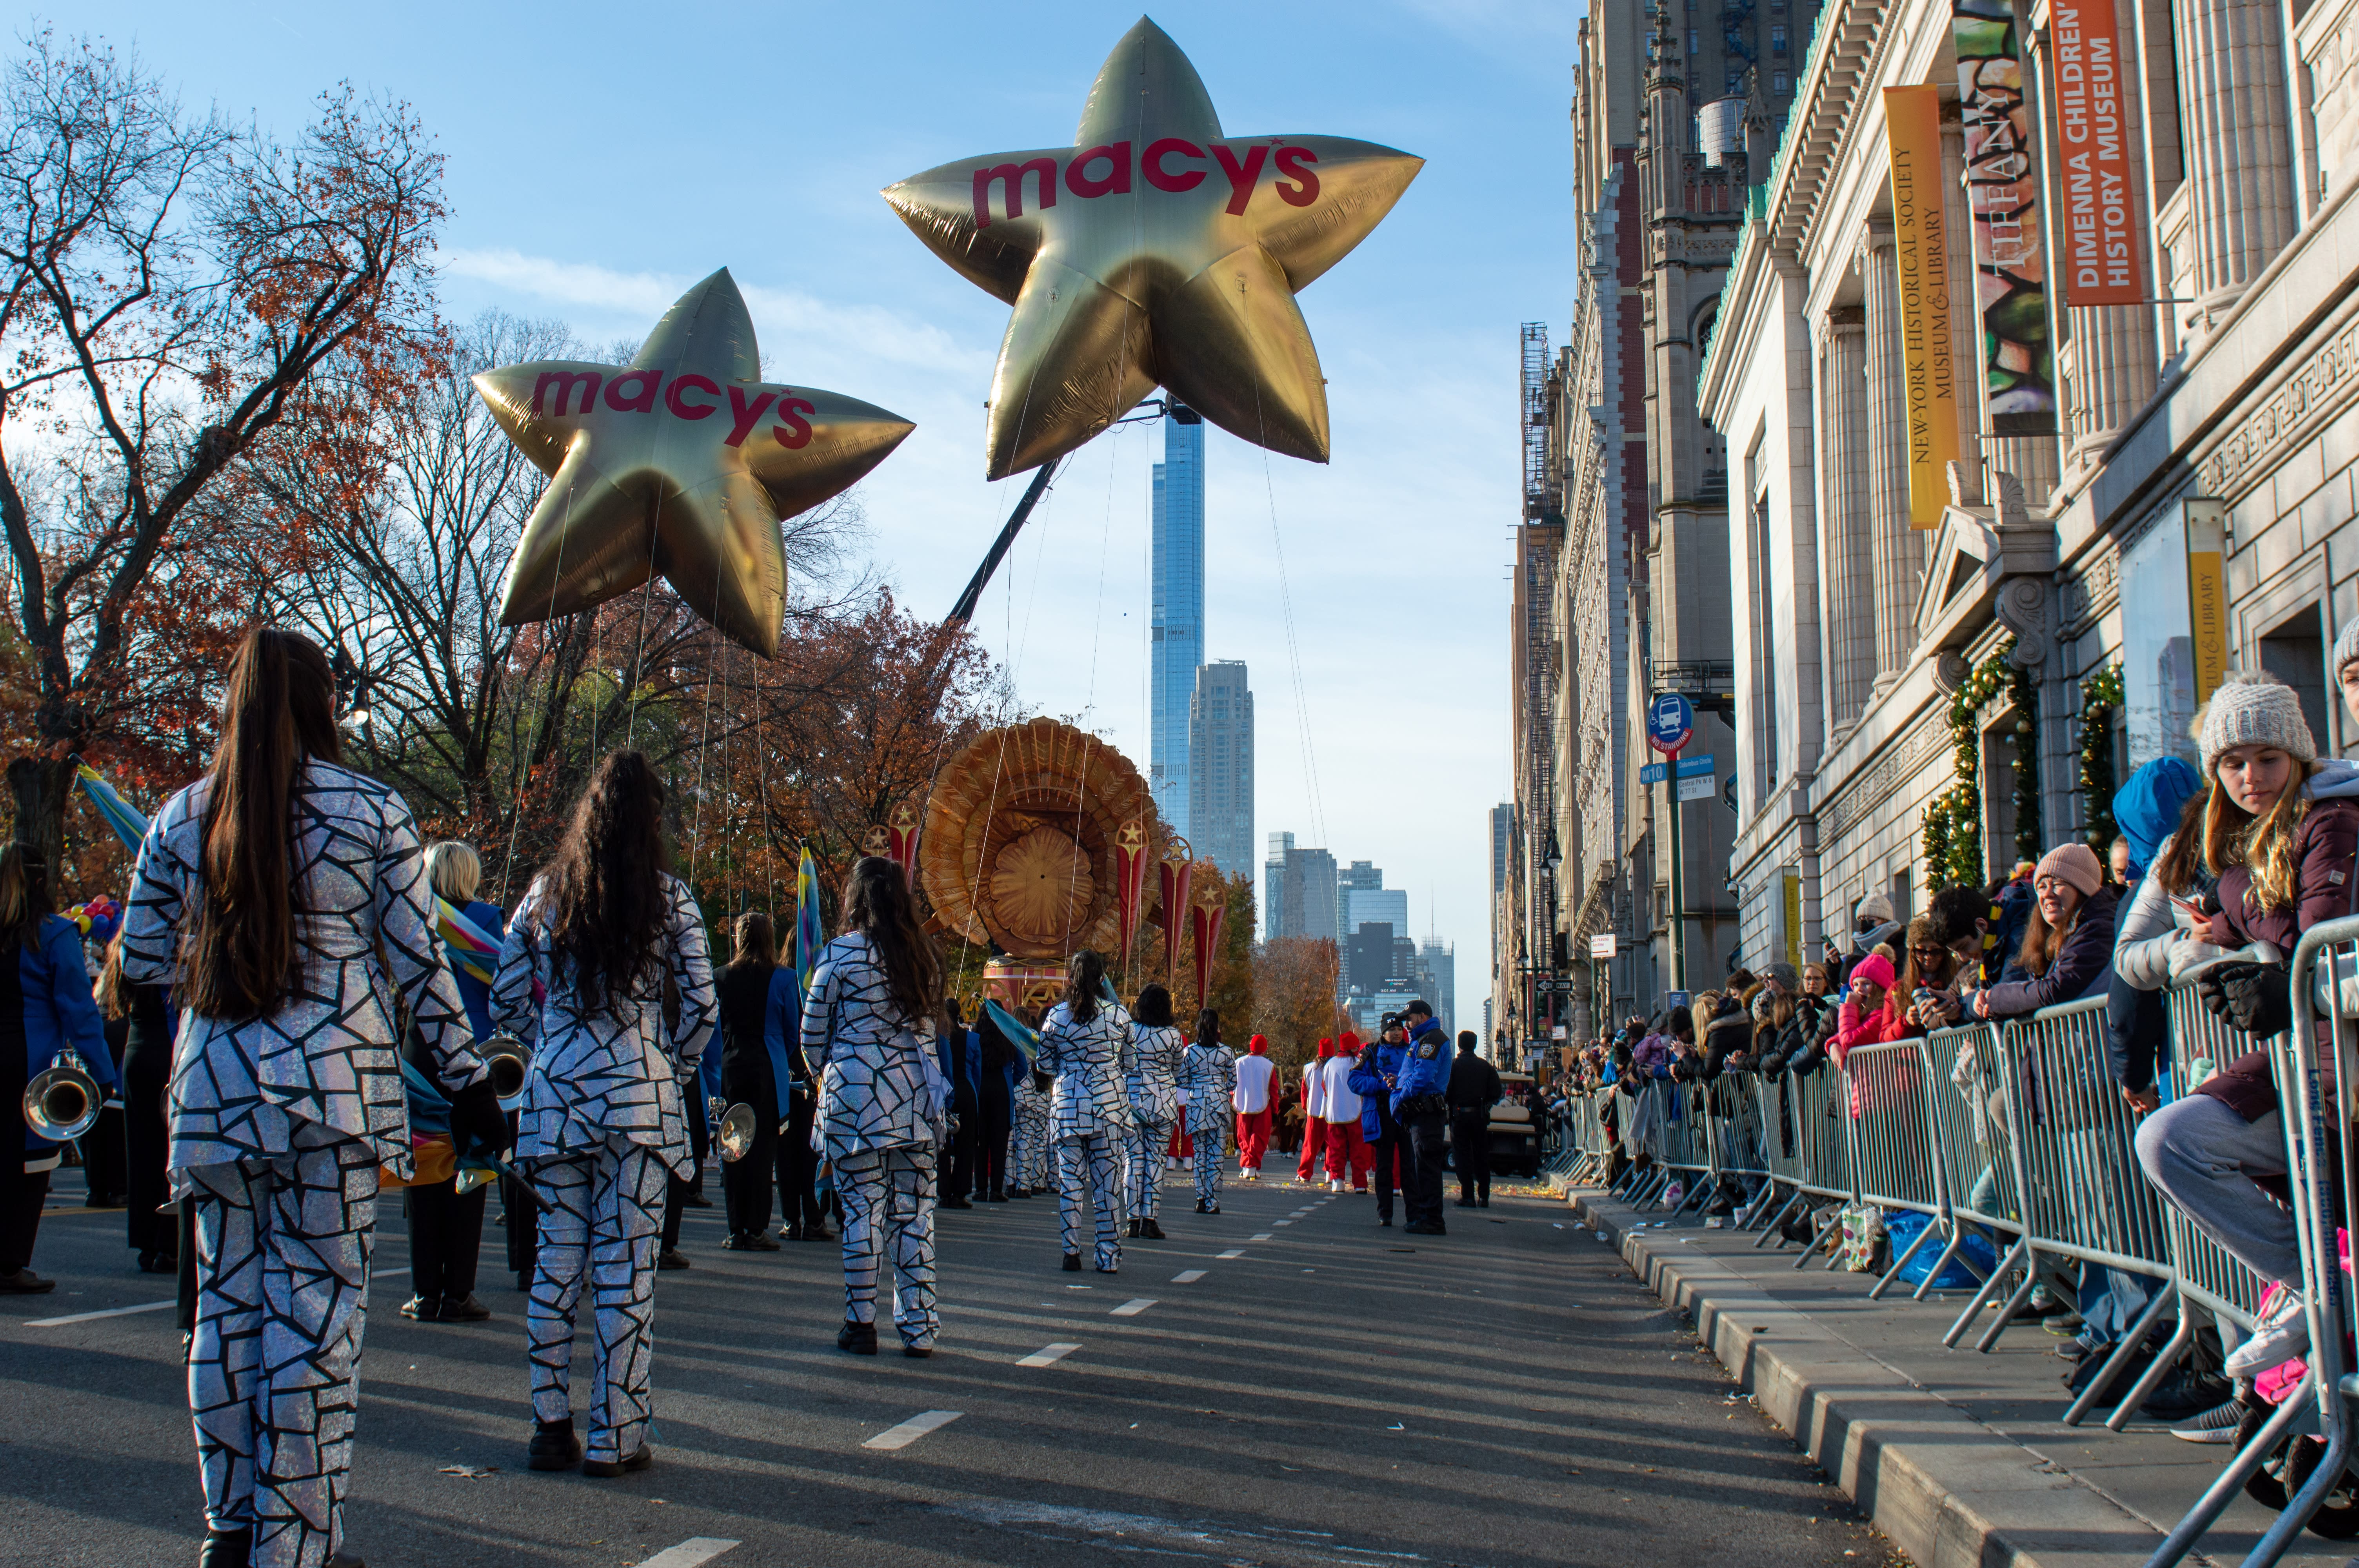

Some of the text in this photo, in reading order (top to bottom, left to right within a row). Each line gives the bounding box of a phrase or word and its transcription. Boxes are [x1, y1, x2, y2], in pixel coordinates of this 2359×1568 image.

[1976, 88, 2026, 277] TIFFANY
[2089, 38, 2130, 287] HISTORY MUSEUM
[2069, 152, 2099, 287] DIMENNA
[1895, 147, 1930, 464] NEW-YORK HISTORICAL SOCIETY
[1924, 207, 1952, 399] MUSEUM & LIBRARY
[2200, 573, 2215, 635] LIBRARY
[2201, 636, 2219, 653] &
[1651, 731, 1689, 750] NO STANDING
[1679, 760, 1699, 769] Columbus
[1642, 766, 1663, 782] M10
[1679, 779, 1695, 788] Central
[2307, 1069, 2322, 1111] Long
